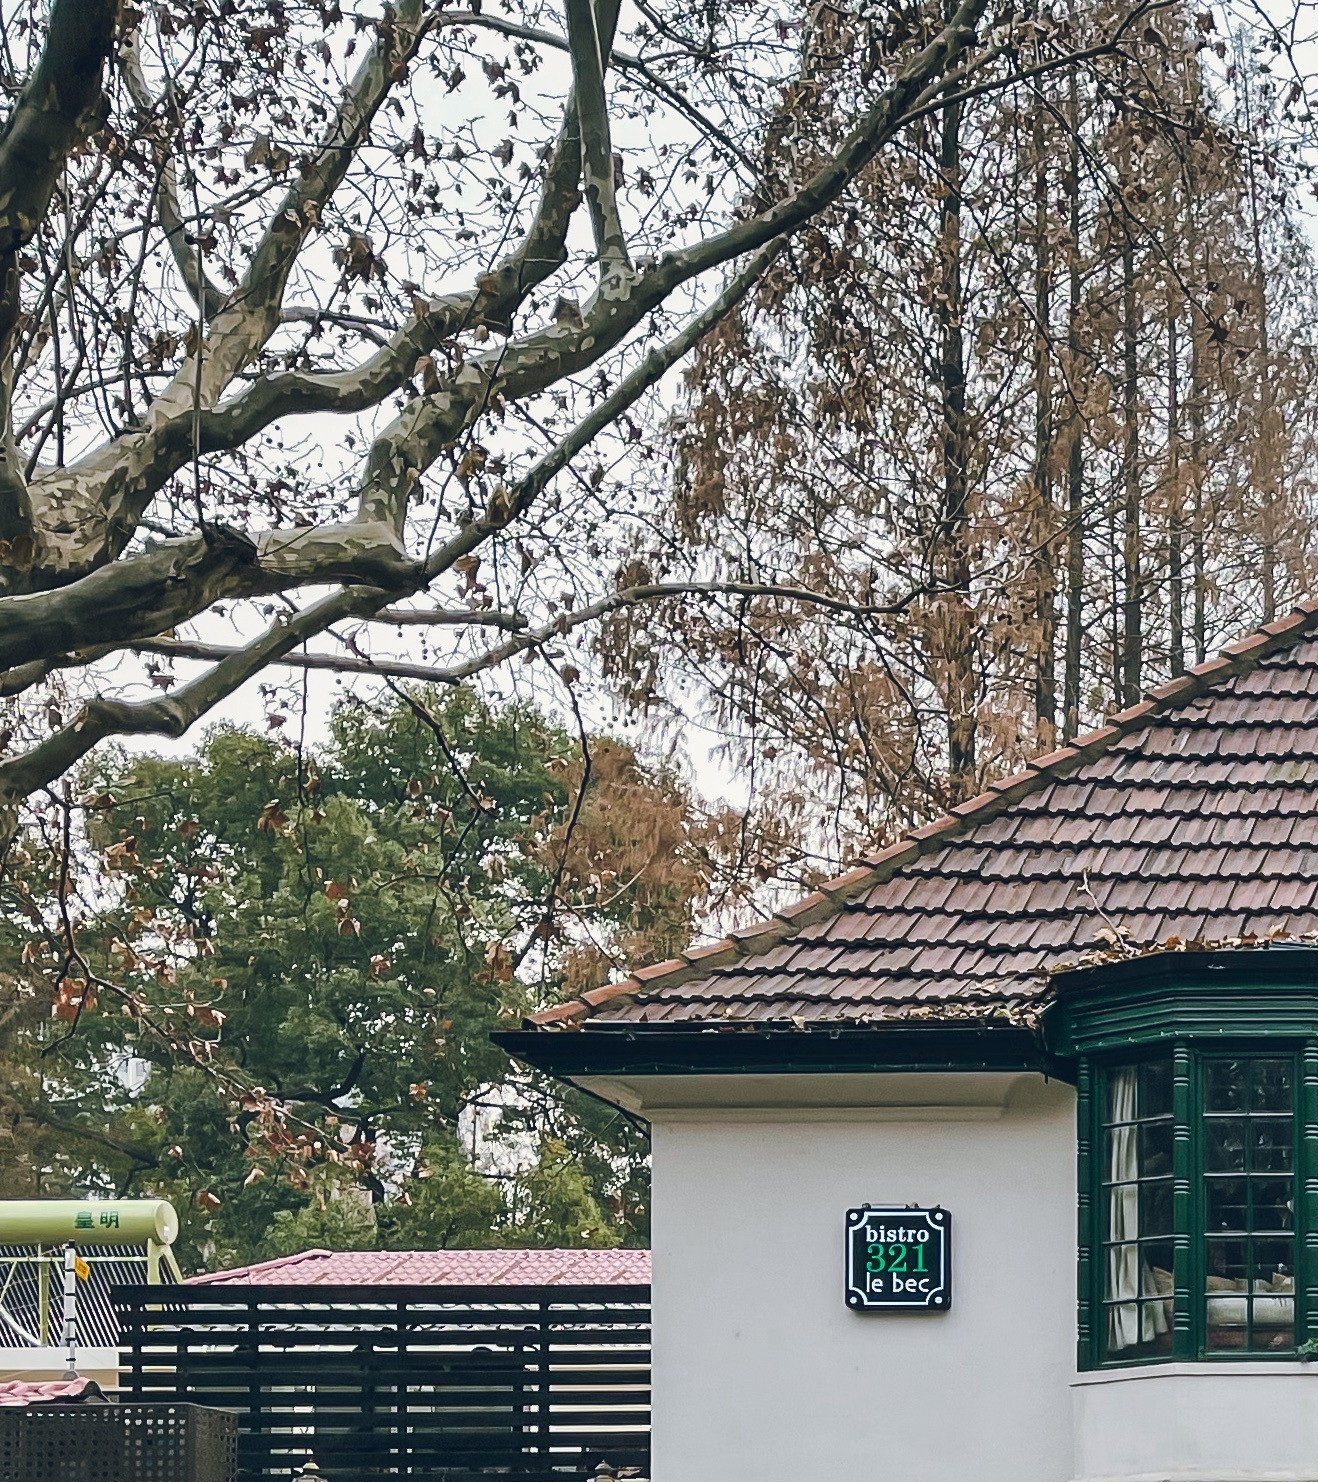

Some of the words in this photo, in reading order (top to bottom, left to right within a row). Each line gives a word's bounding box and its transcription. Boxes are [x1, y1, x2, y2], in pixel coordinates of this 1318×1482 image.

[75, 1210, 120, 1230] 皇明
[865, 1224, 930, 1243] bistro
[866, 1243, 929, 1272] 321
[866, 1272, 884, 1292] le
[892, 1272, 930, 1292] bec
